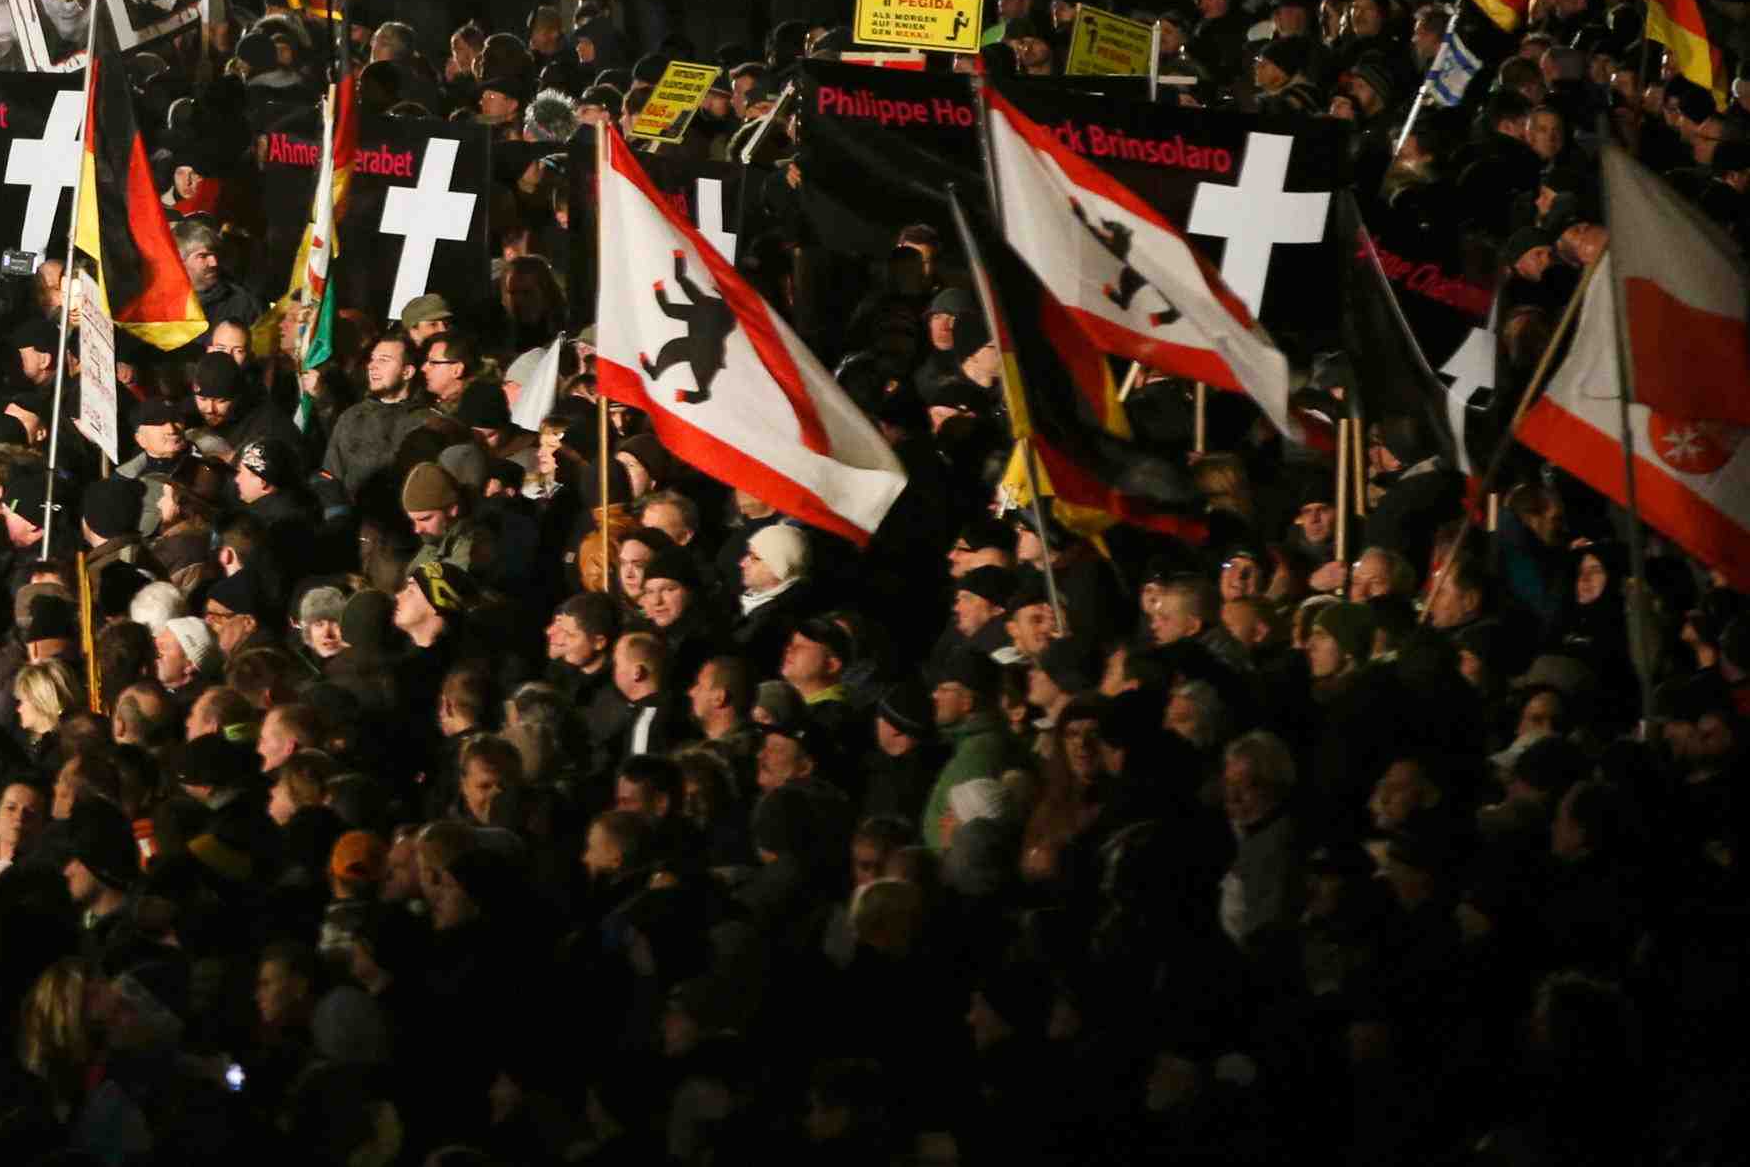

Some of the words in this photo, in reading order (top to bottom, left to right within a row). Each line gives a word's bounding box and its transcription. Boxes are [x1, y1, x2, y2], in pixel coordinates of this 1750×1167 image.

[895, 14, 938, 23] MORGEN
[816, 86, 928, 124] Philippe
[268, 132, 321, 168] Ahme
[353, 144, 414, 177] erabet
[1092, 124, 1233, 172] Brinsolaro
